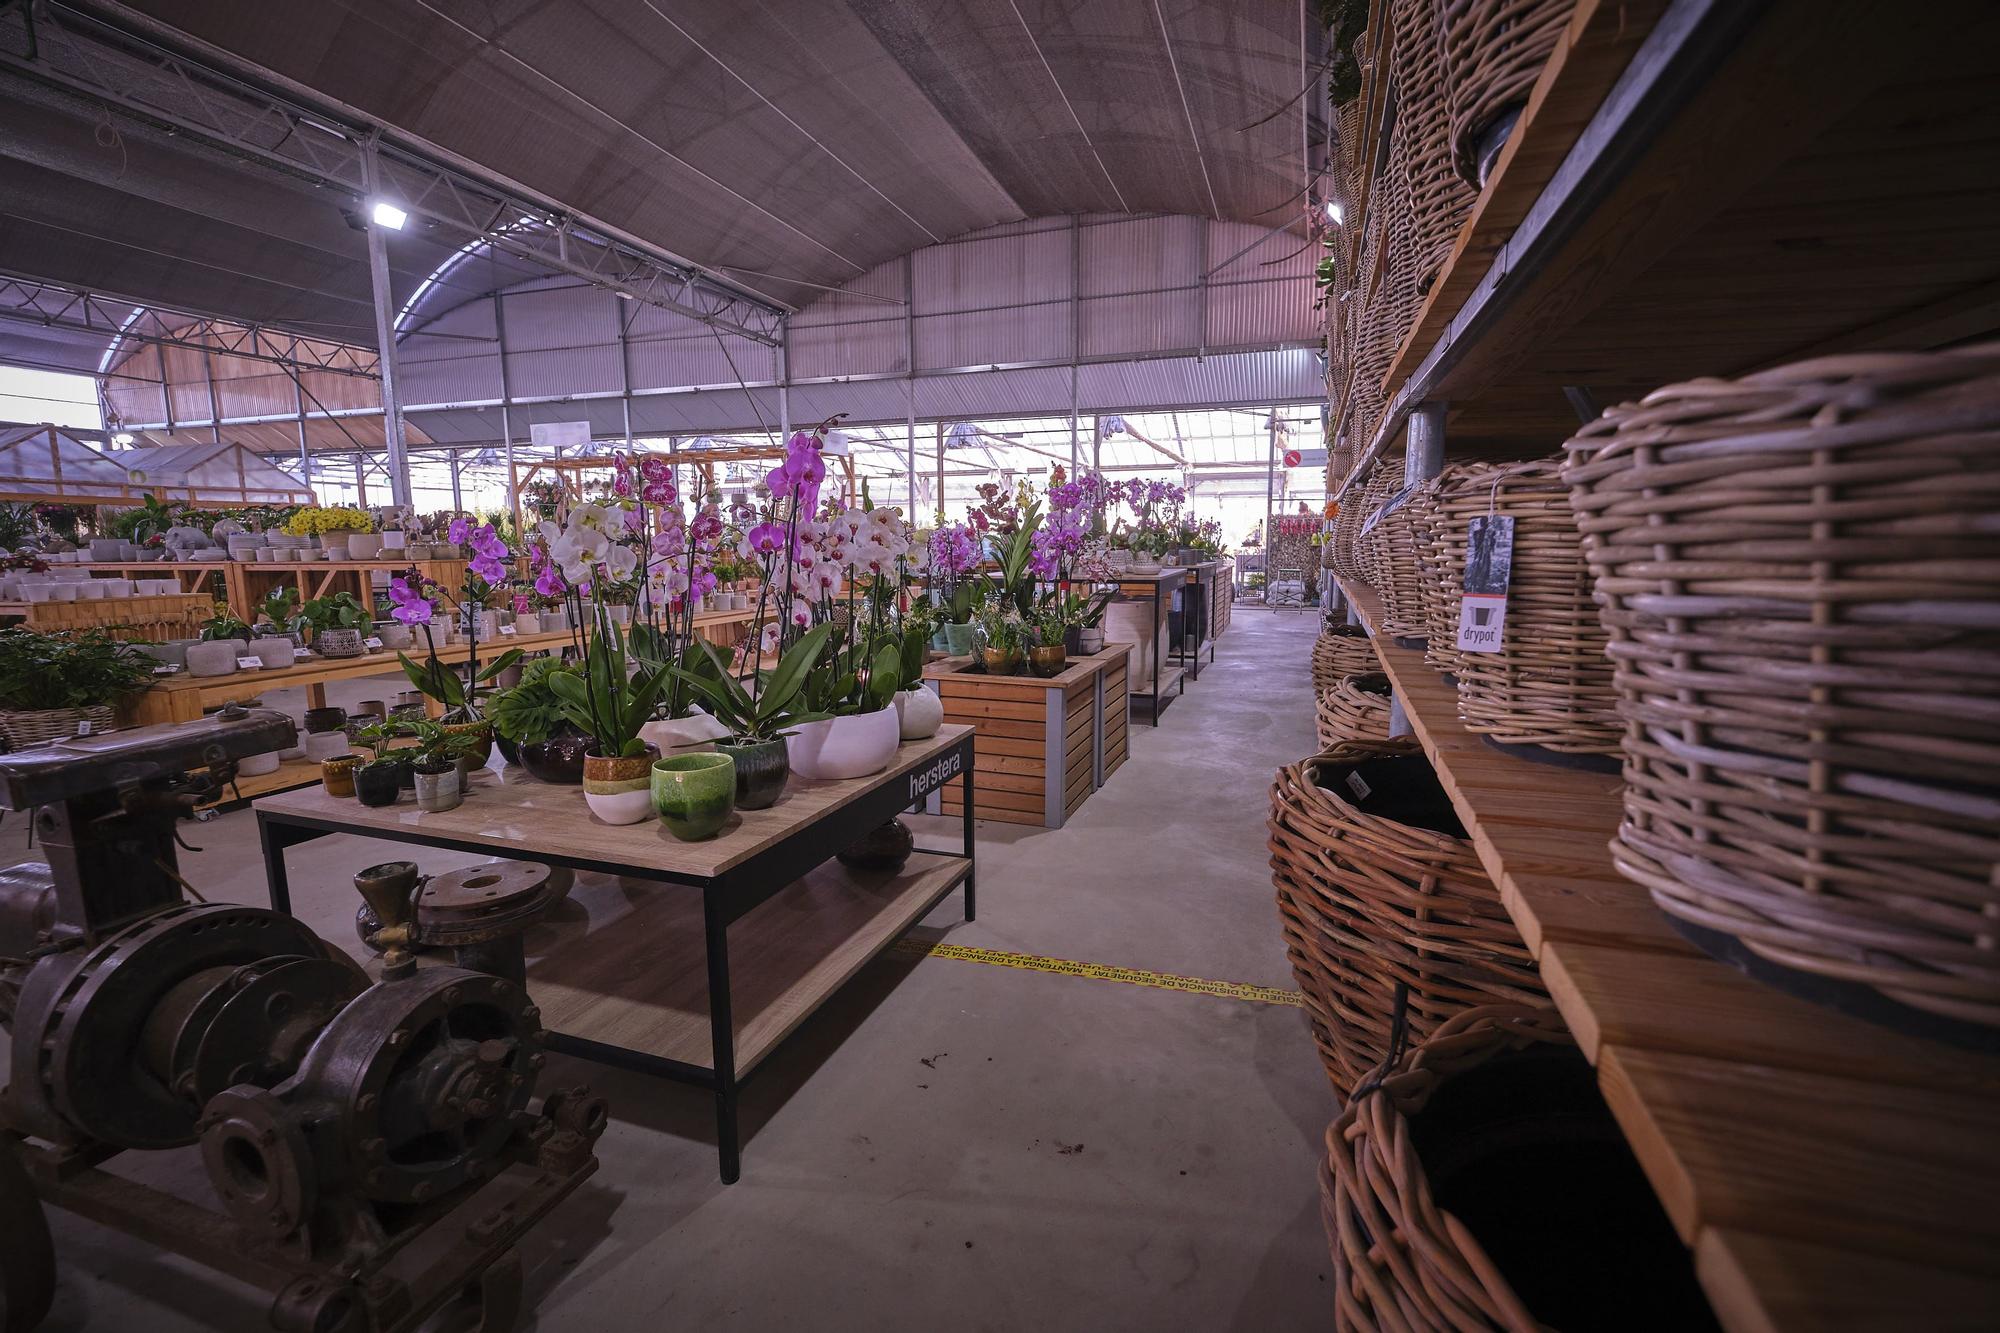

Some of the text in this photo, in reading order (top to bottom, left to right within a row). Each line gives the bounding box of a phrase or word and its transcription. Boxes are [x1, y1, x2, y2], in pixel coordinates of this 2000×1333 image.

[1464, 626, 1495, 644] drypot
[909, 753, 960, 799] herstera
[952, 951, 1006, 963] DISTANCIA
[1022, 961, 1083, 974] MANTENGA
[1159, 979, 1175, 987] DE
[1178, 981, 1239, 996] DISTANCIA
